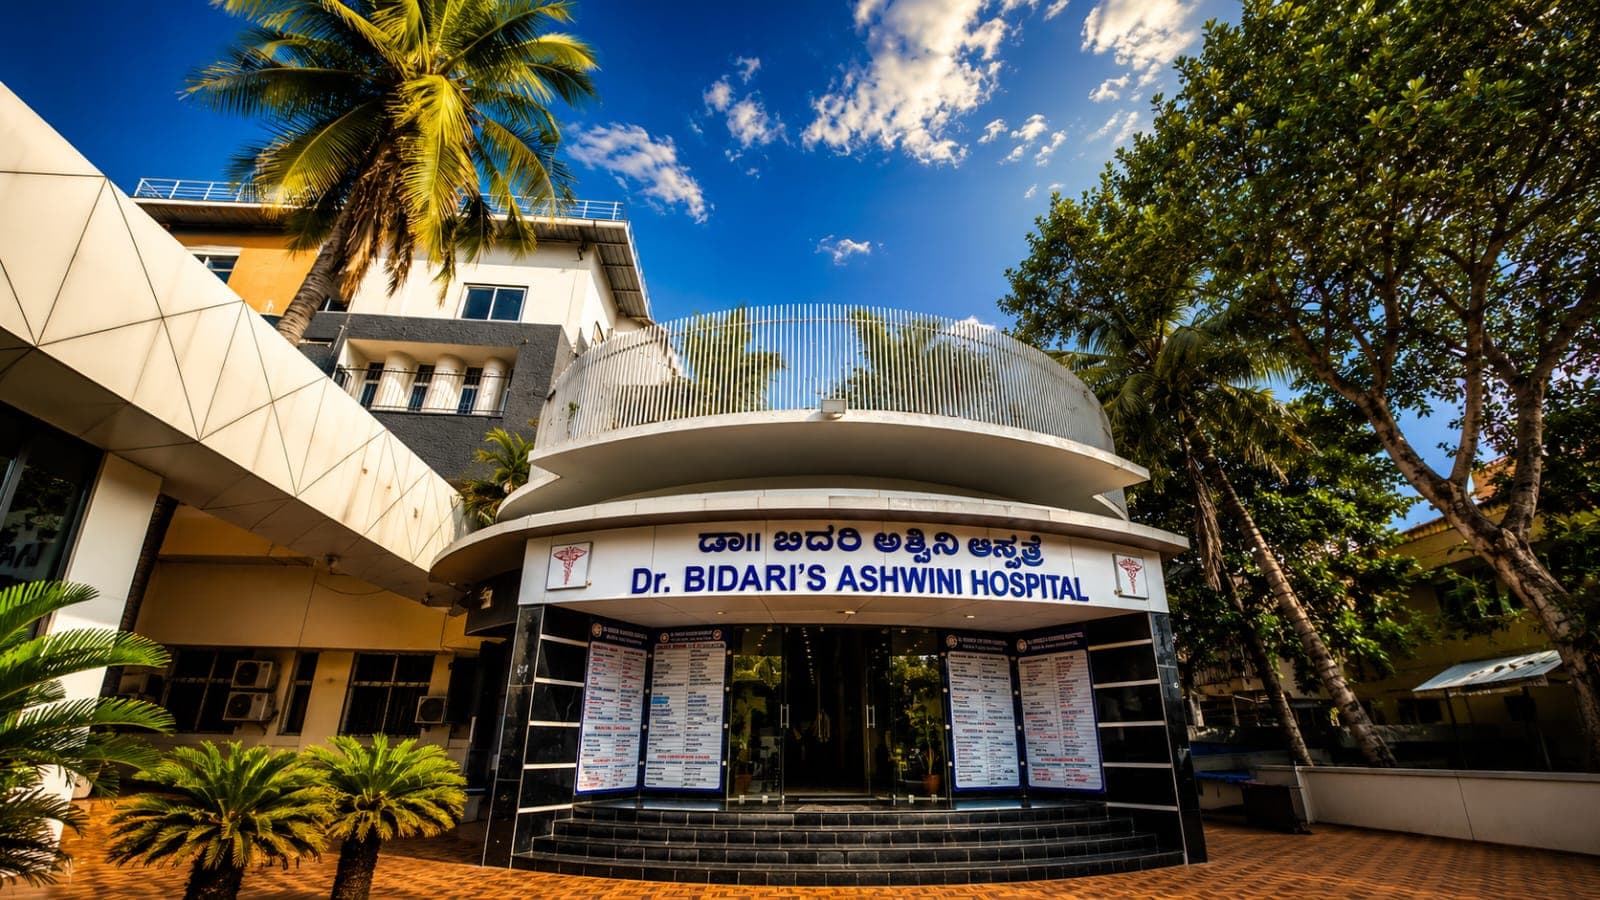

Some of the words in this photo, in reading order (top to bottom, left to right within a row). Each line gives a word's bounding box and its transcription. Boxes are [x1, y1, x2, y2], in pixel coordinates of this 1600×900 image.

[774, 524, 862, 552] ಬಿದರಿ
[967, 533, 1045, 570] ಆಸ್ಪತ್ರೆ
[631, 567, 671, 594] Dr.
[684, 564, 827, 593] BIDARI’S
[836, 565, 963, 596] ASHWINI
[970, 569, 1090, 602] HOSPITAL
